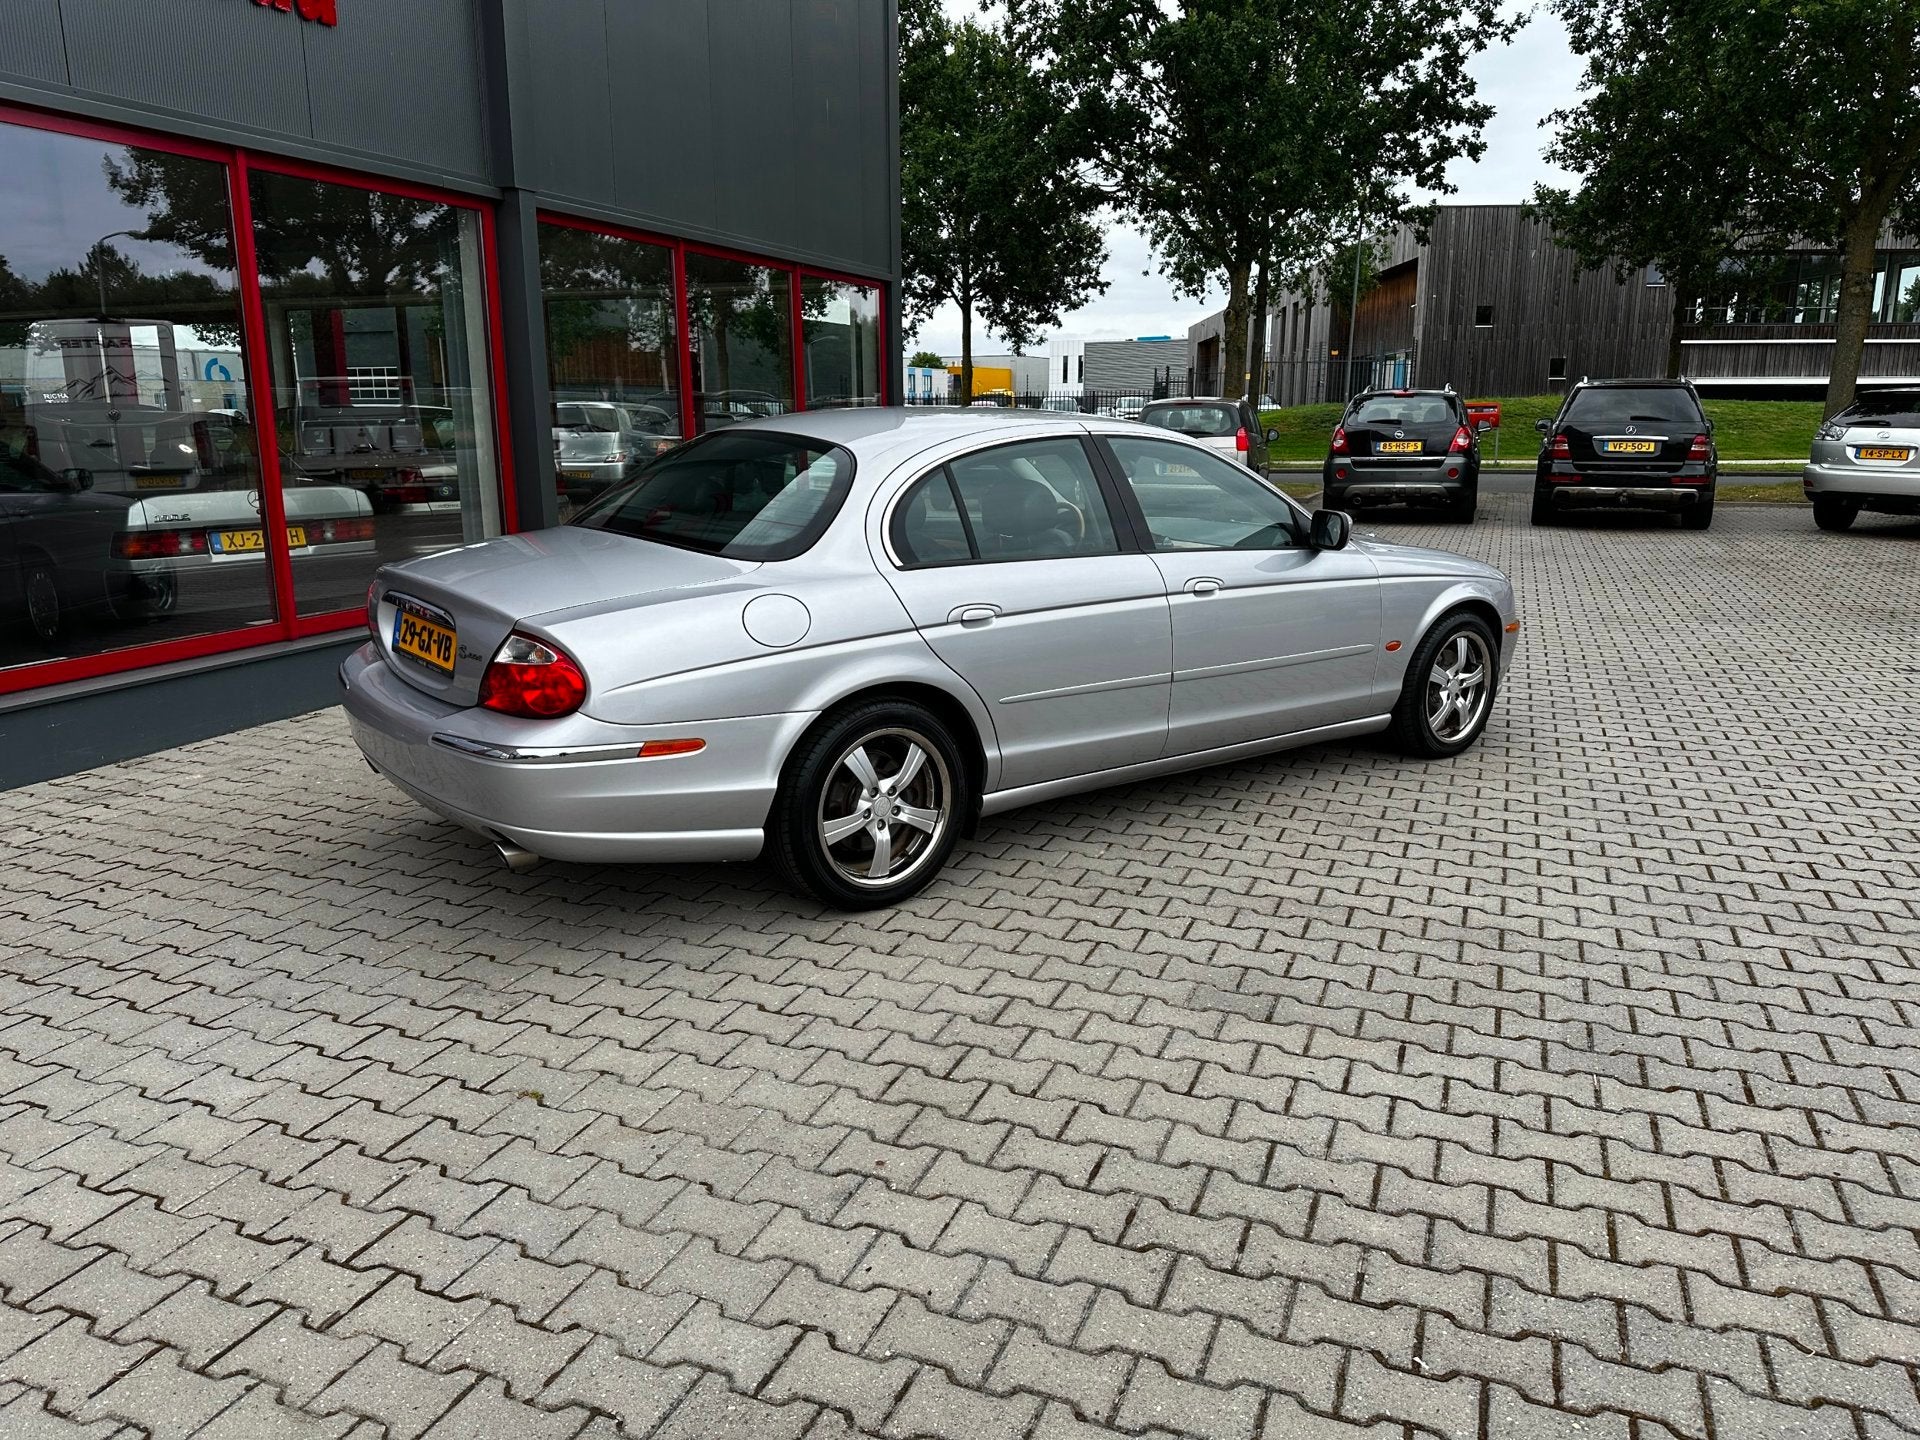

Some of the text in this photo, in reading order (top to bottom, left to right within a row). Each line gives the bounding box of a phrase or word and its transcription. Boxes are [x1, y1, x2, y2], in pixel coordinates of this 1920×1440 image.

[1382, 442, 1419, 450] 85-HSF-5
[1612, 442, 1651, 450] VFJ-50-J
[1864, 448, 1904, 459] 14-SP-LX
[401, 618, 453, 663] 29-GX-VB
